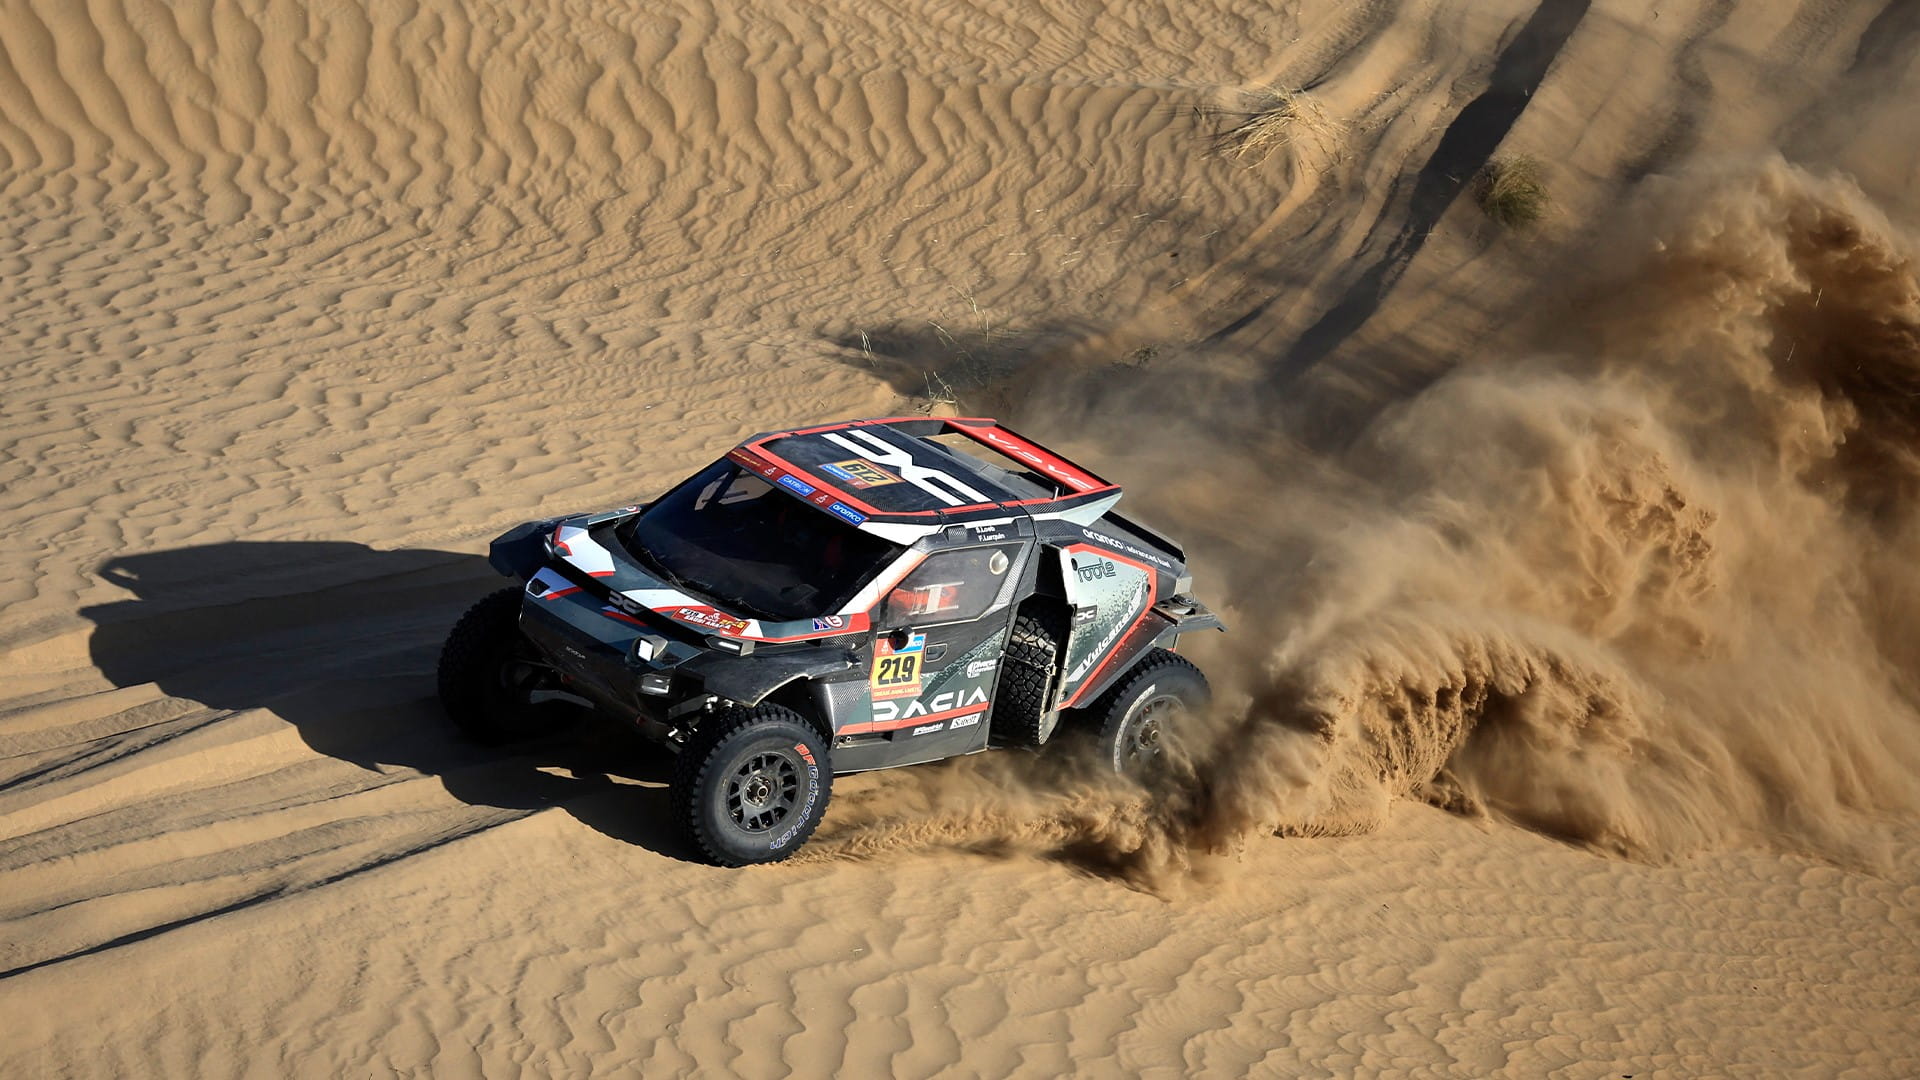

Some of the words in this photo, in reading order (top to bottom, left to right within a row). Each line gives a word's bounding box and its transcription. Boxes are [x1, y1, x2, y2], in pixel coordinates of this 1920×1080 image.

[841, 463, 888, 483] 219
[988, 432, 1095, 490] DACIA
[832, 504, 862, 523] aramco
[1083, 528, 1124, 550] aramco
[877, 655, 916, 686] 219
[872, 685, 988, 722] DACIA
